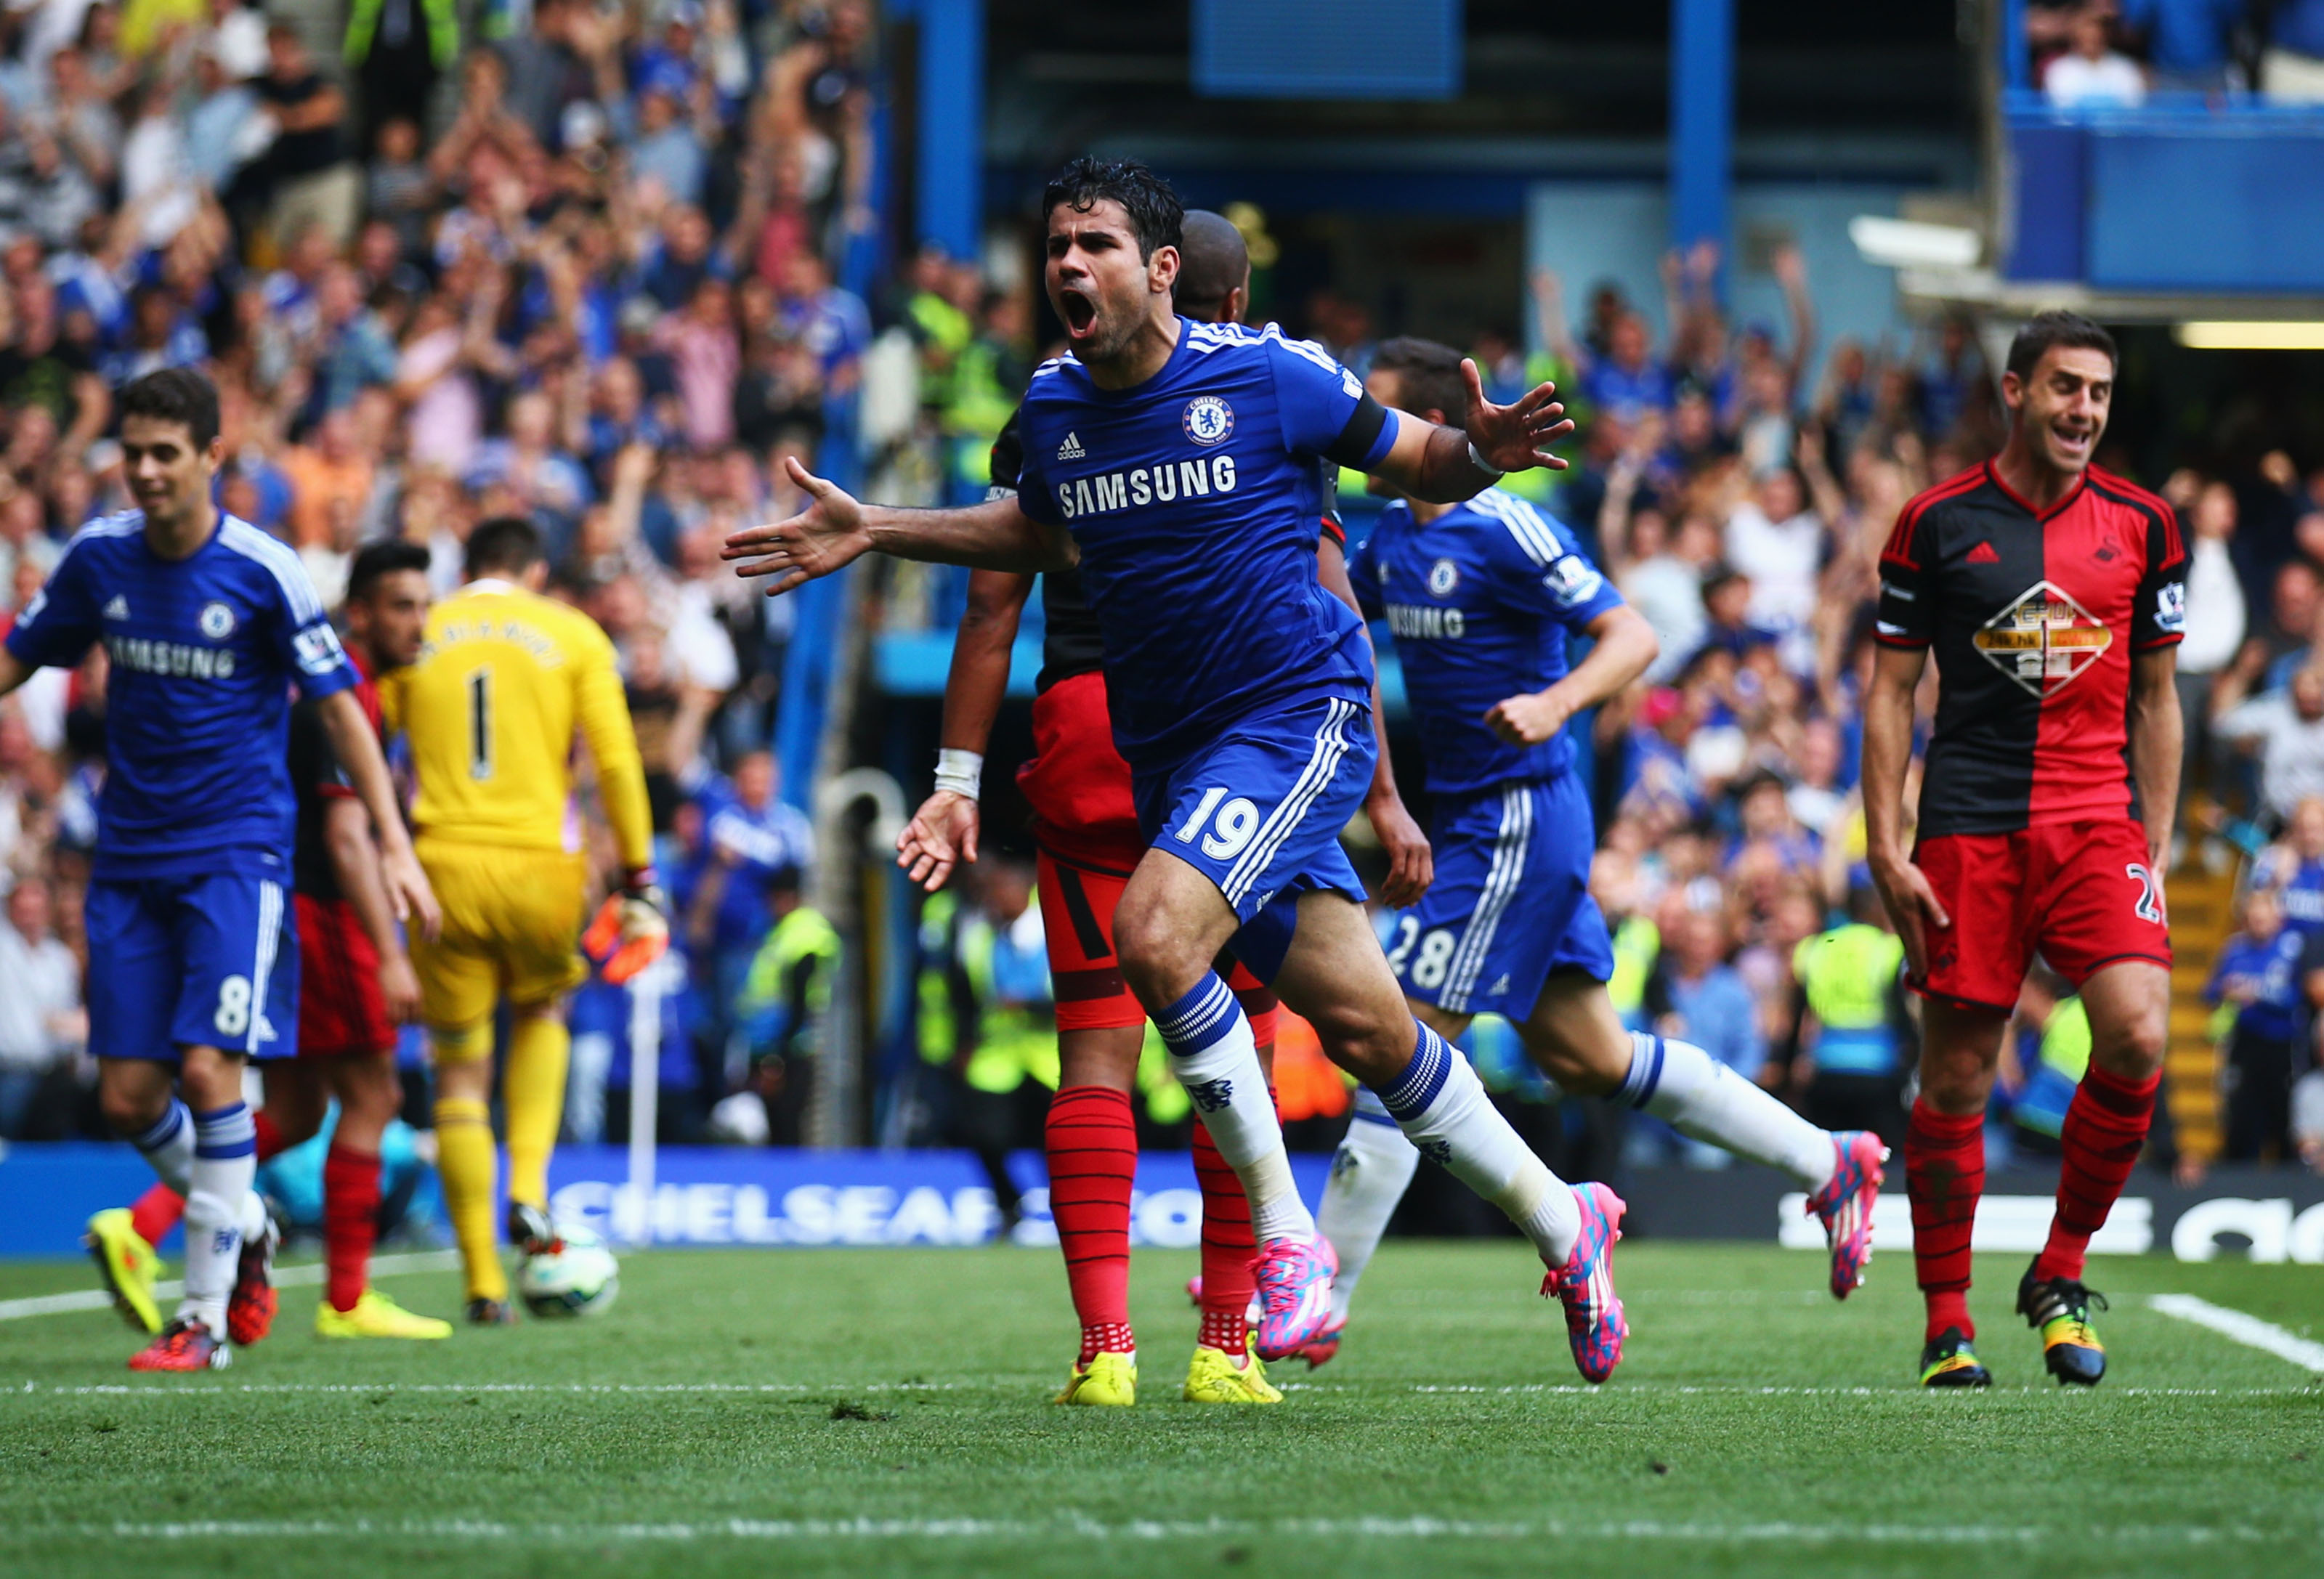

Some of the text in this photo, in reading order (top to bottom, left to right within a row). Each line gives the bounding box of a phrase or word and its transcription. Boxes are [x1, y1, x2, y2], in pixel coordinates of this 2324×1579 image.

[1189, 397, 1223, 410] CHELSEA
[1058, 448, 1085, 460] adidas
[1058, 455, 1236, 519] SAMSUNG
[468, 664, 495, 780] 1
[1174, 787, 1259, 861] 19
[1385, 914, 1456, 989] 28
[214, 973, 252, 1038] 8
